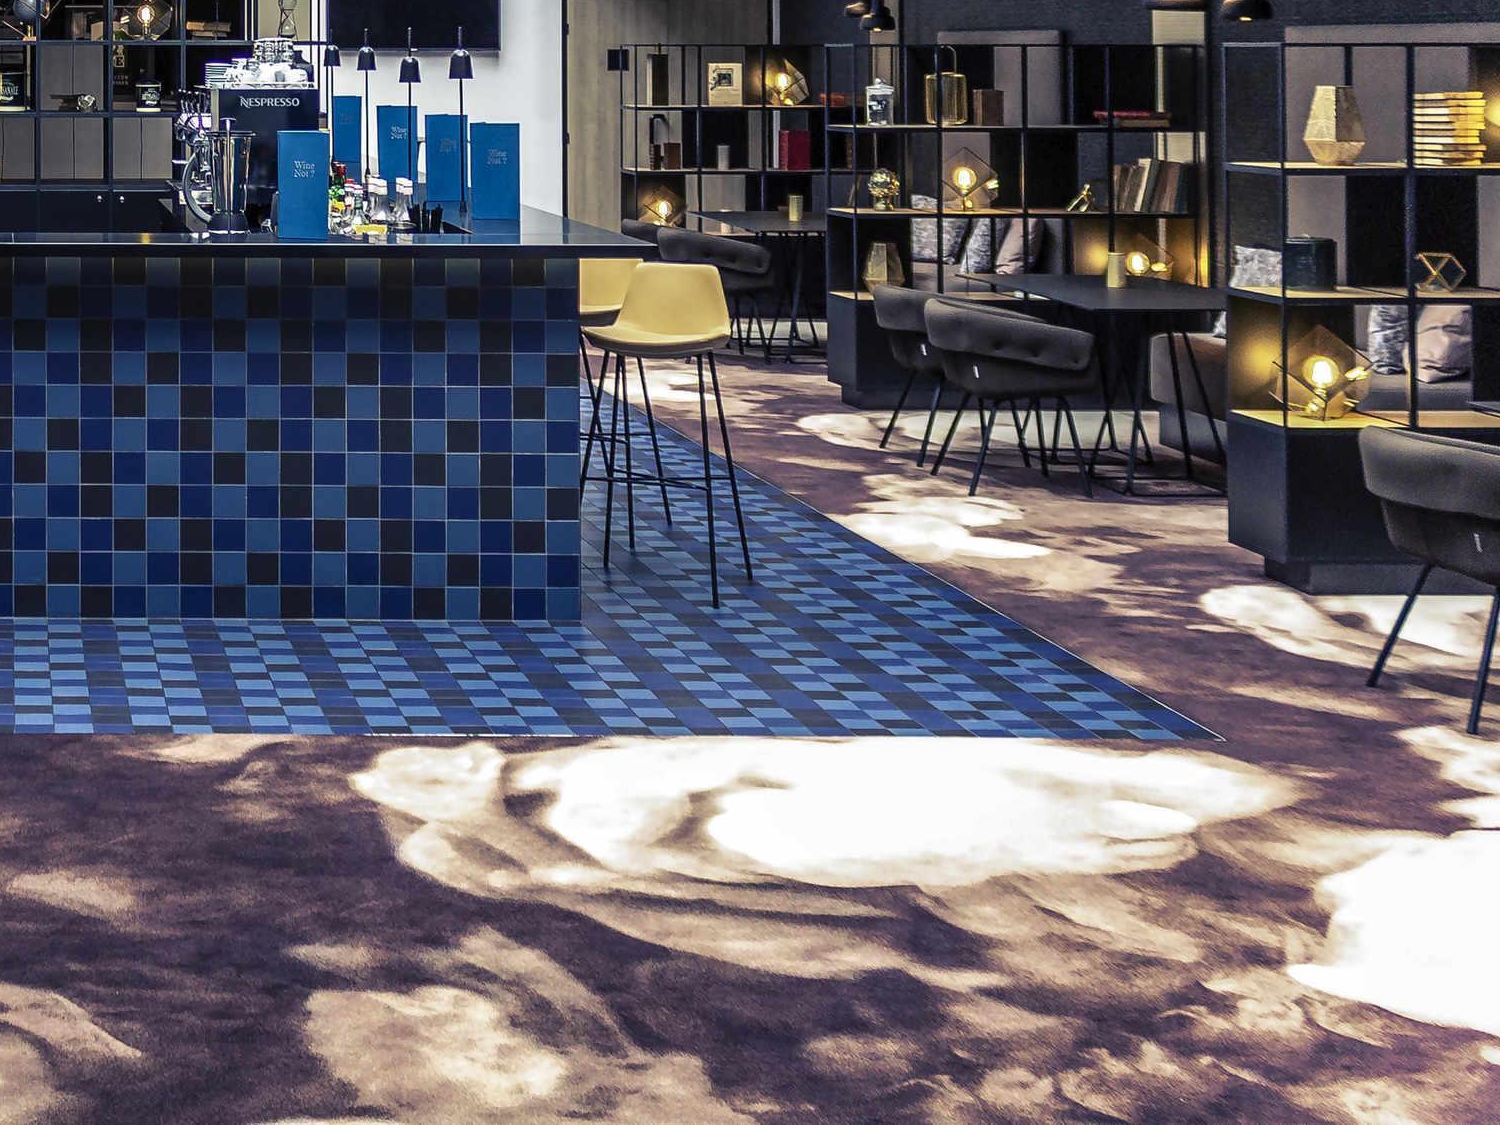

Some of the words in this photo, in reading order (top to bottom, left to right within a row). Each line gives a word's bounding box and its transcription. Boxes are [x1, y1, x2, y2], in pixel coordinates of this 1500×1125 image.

[239, 96, 300, 108] NESPRESSO
[294, 160, 315, 170] Wine
[294, 169, 309, 177] Not
